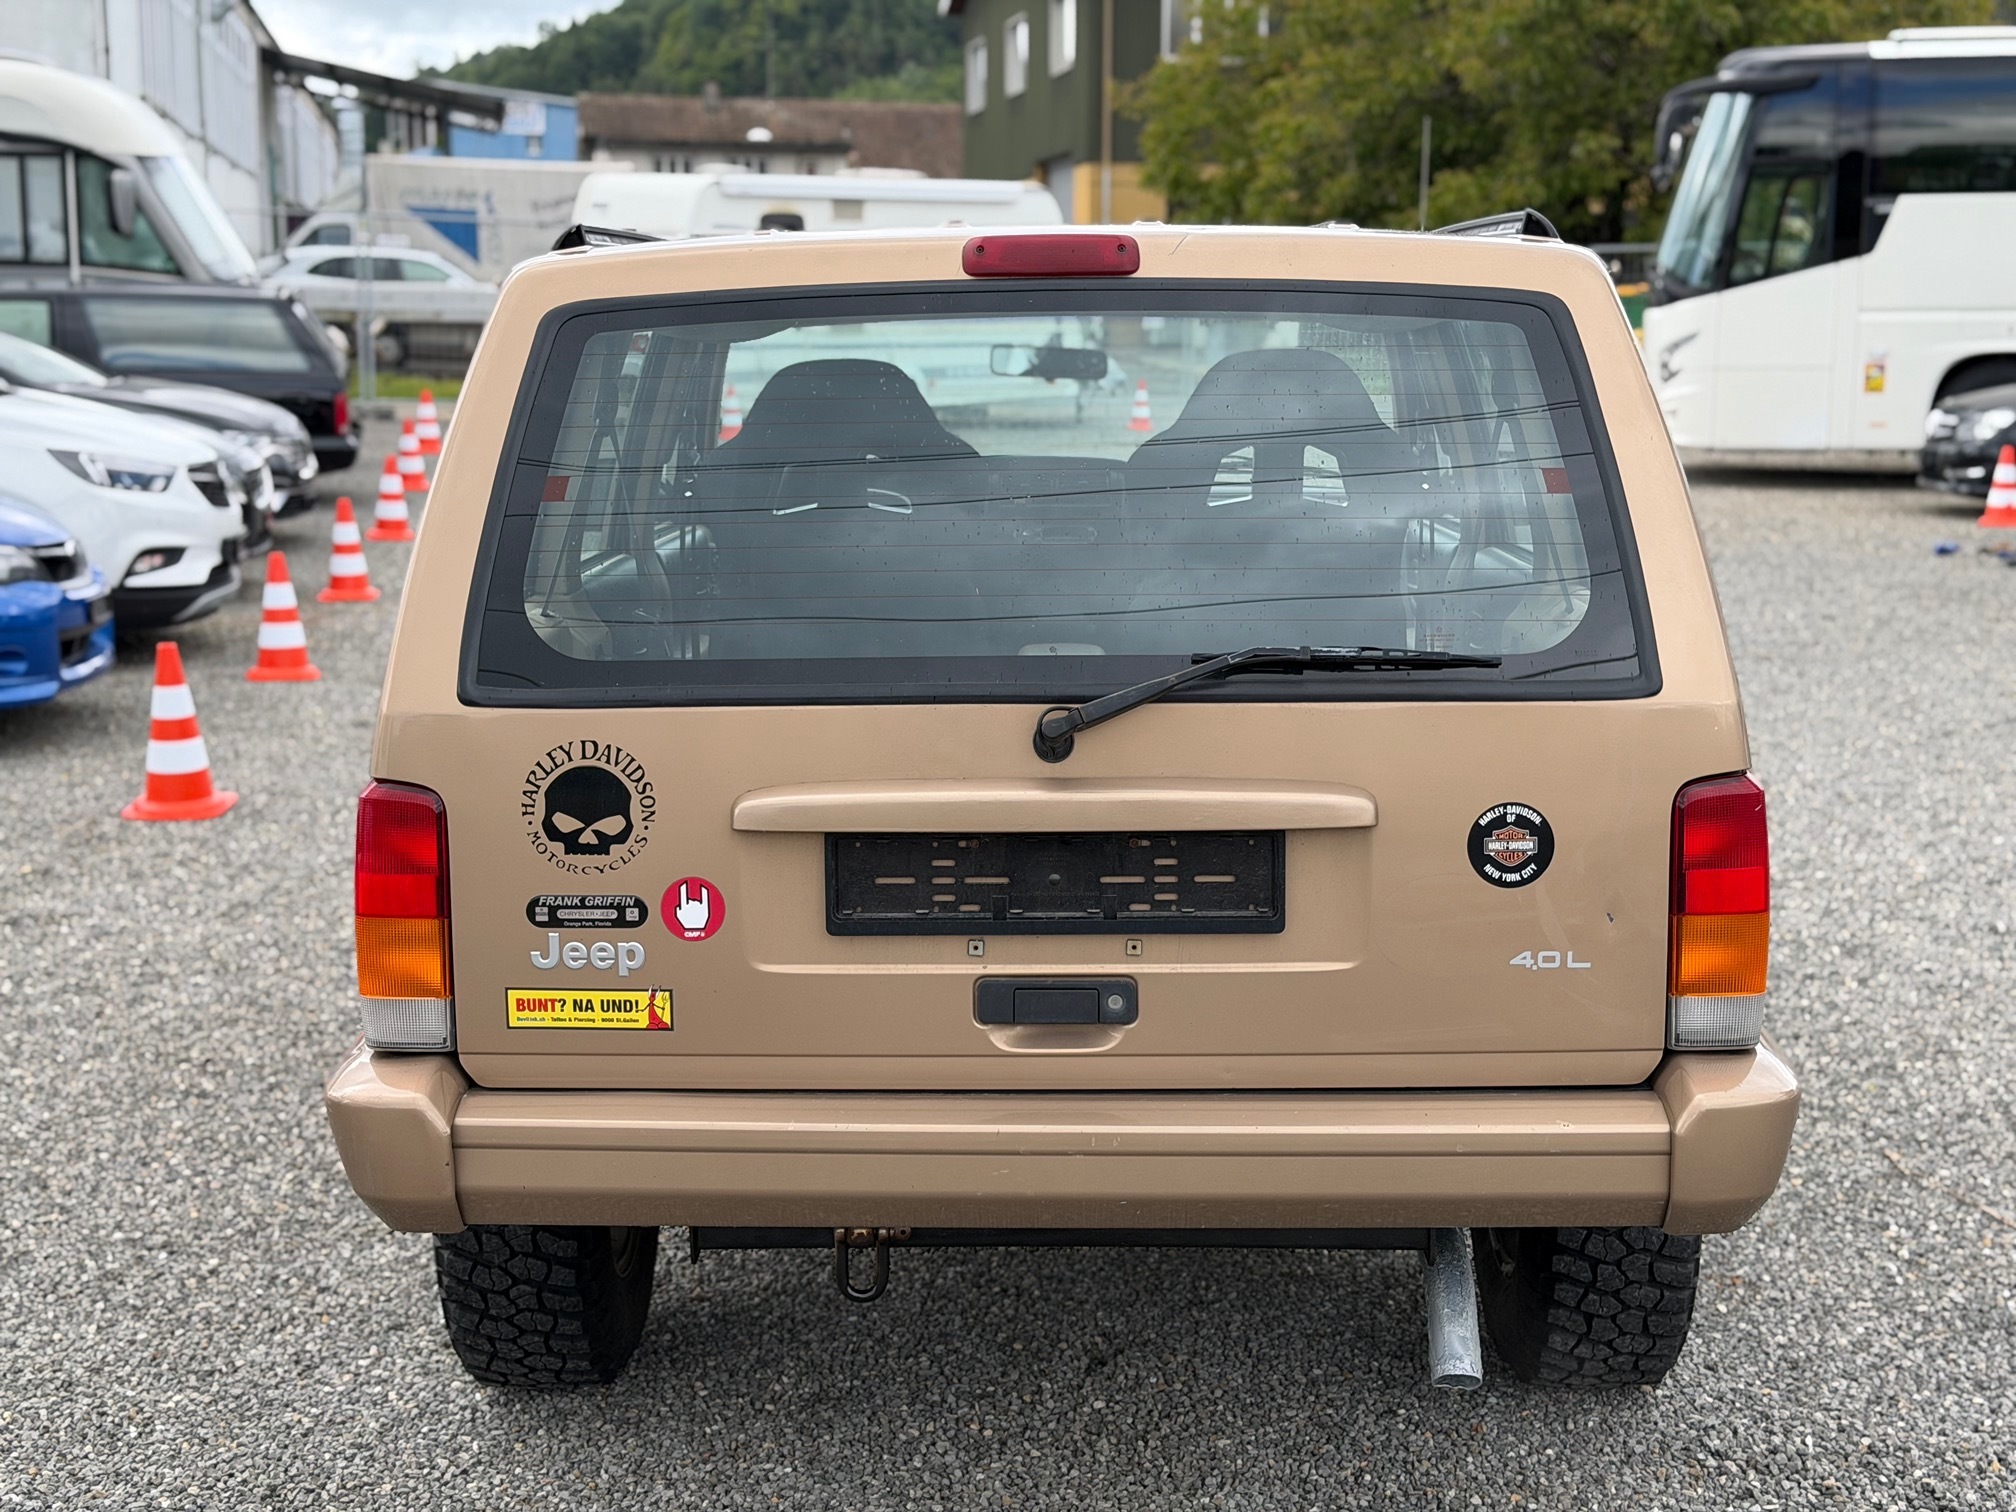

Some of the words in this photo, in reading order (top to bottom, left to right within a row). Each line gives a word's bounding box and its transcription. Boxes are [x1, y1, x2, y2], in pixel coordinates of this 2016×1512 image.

[521, 741, 575, 817] HARLEY
[579, 739, 656, 823] DAVIDSON
[1478, 805, 1542, 827] HARLEY-DAVIDSON
[1506, 814, 1516, 823] OF
[1498, 830, 1524, 839] MOTOR
[526, 830, 649, 875] MOTORCYCLES
[1488, 841, 1534, 850] HARLEY-DAVIDSON
[1498, 852, 1524, 861] CYCLES
[1483, 863, 1501, 880] NEW
[1502, 872, 1521, 883] YORK
[1521, 862, 1538, 879] CITY
[538, 896, 582, 907] FRANK
[585, 896, 636, 907] GRIFFIN
[530, 932, 646, 977] Jeep
[515, 997, 567, 1013] BUNT?
[572, 998, 596, 1013] NA
[600, 999, 639, 1014] UND!
